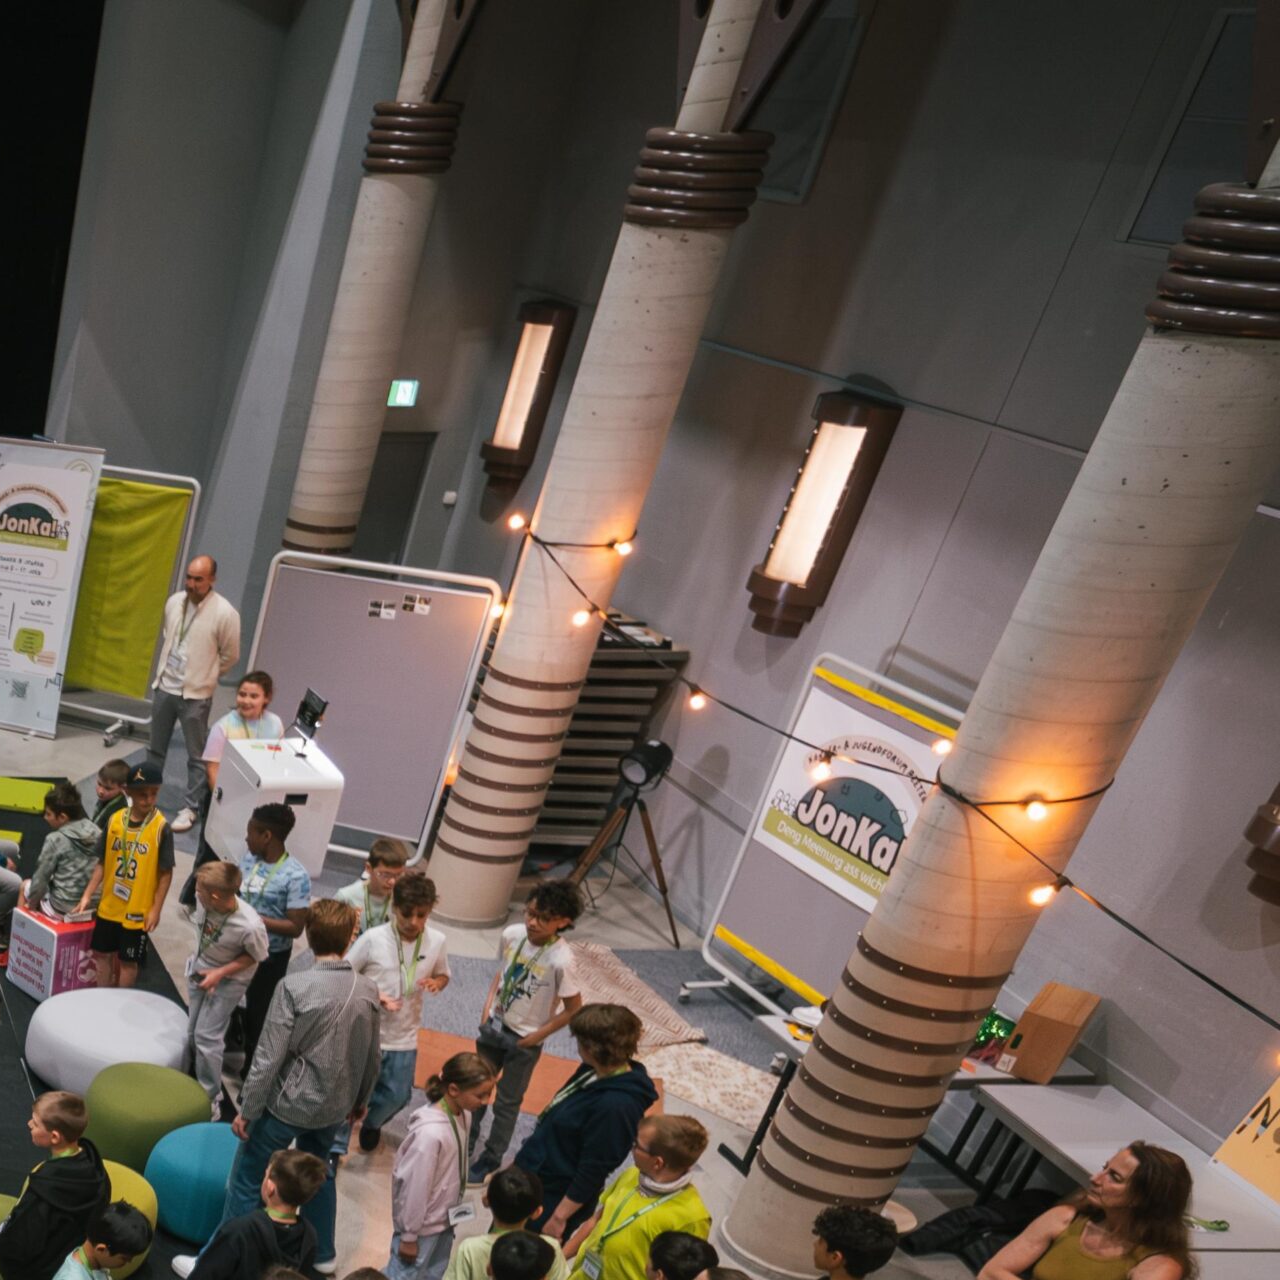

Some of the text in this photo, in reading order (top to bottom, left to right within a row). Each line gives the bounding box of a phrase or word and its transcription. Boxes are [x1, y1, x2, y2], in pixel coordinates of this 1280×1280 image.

[115, 857, 138, 880] 23
[776, 820, 802, 847] Deng
[802, 834, 844, 871] Meenung
[843, 862, 860, 879] ass
